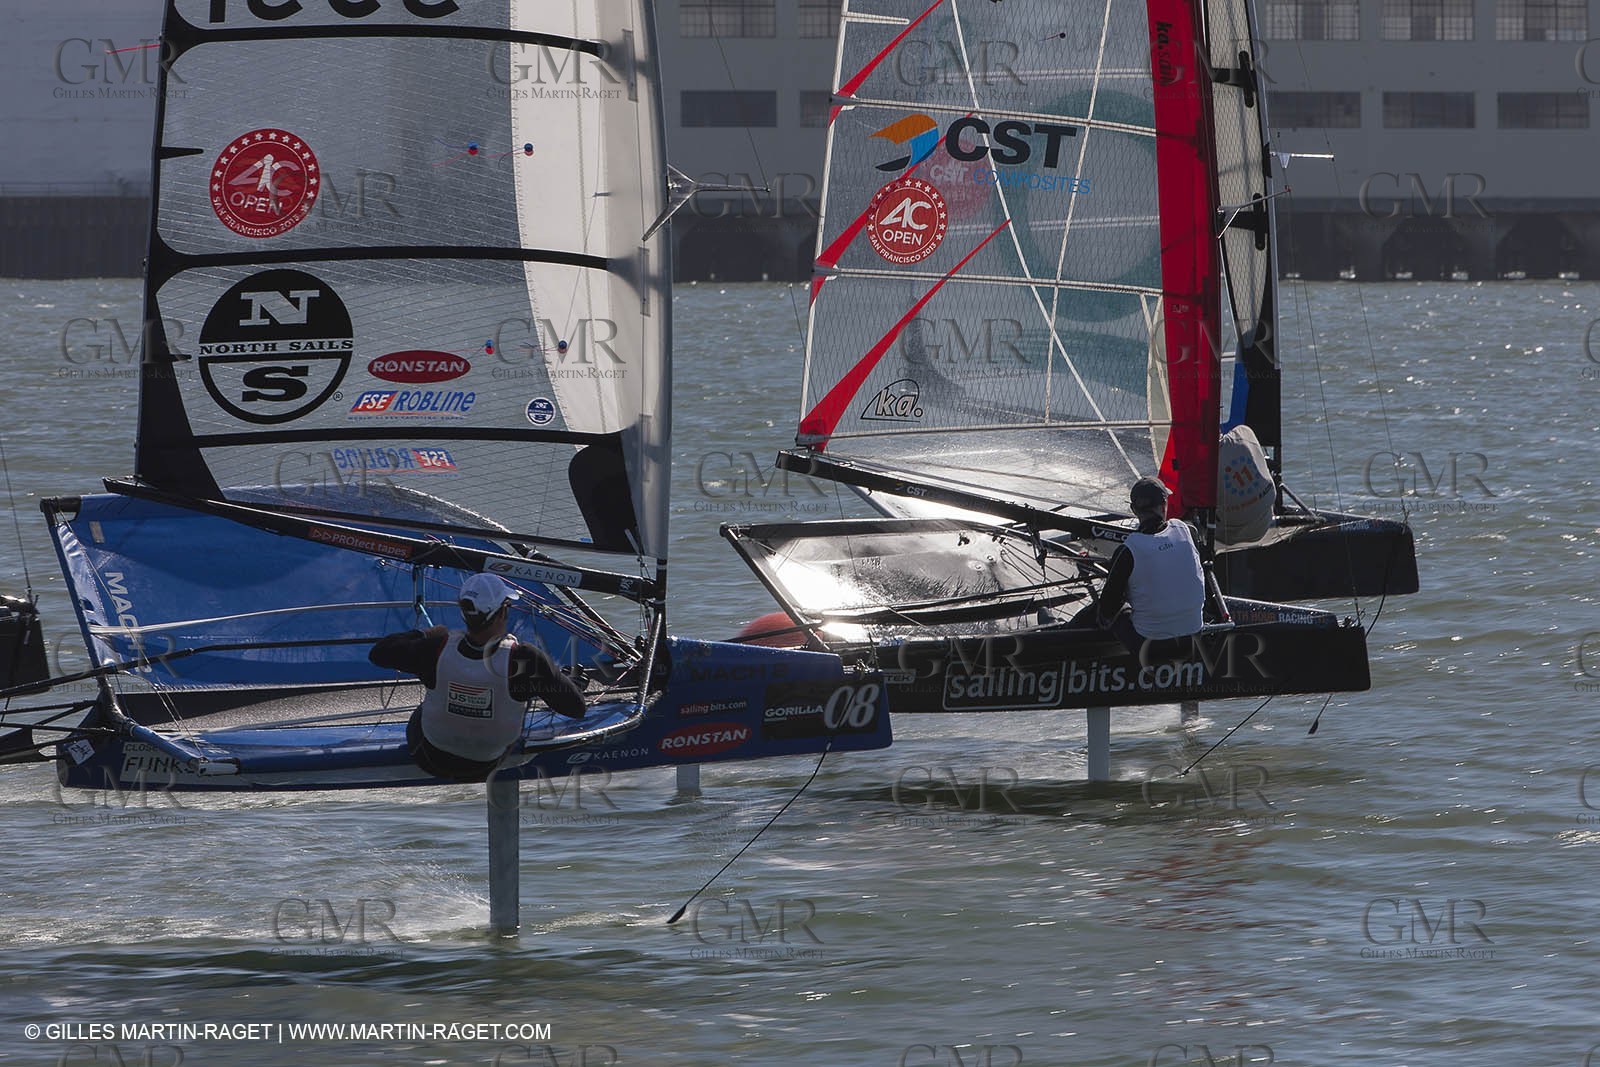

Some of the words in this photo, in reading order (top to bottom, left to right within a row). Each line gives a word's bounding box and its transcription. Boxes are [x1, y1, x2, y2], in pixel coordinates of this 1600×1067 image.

[945, 117, 1077, 169] CST
[973, 168, 1091, 195] COMPOSITES
[230, 191, 283, 215] OPEN
[213, 196, 227, 216] SAN
[224, 215, 277, 236] FRANCISCO
[879, 197, 932, 230] AC
[882, 229, 923, 246] OPEN
[869, 234, 881, 250] SAN
[879, 248, 921, 263] FRANCISCO
[922, 242, 937, 257] 2013
[239, 289, 320, 326] N
[200, 342, 278, 355] NORTH
[289, 340, 354, 351] SAILS
[372, 360, 465, 373] RONSTAN
[241, 365, 309, 402] S
[358, 394, 390, 409] FSE
[906, 486, 928, 497] CST
[514, 567, 577, 584] KAENON
[1279, 613, 1313, 625] RACING
[448, 692, 467, 702] US
[824, 683, 879, 729] 08
[764, 705, 824, 717] GORILLA
[661, 728, 748, 750] RONSTAN
[594, 747, 649, 760] KAENON
